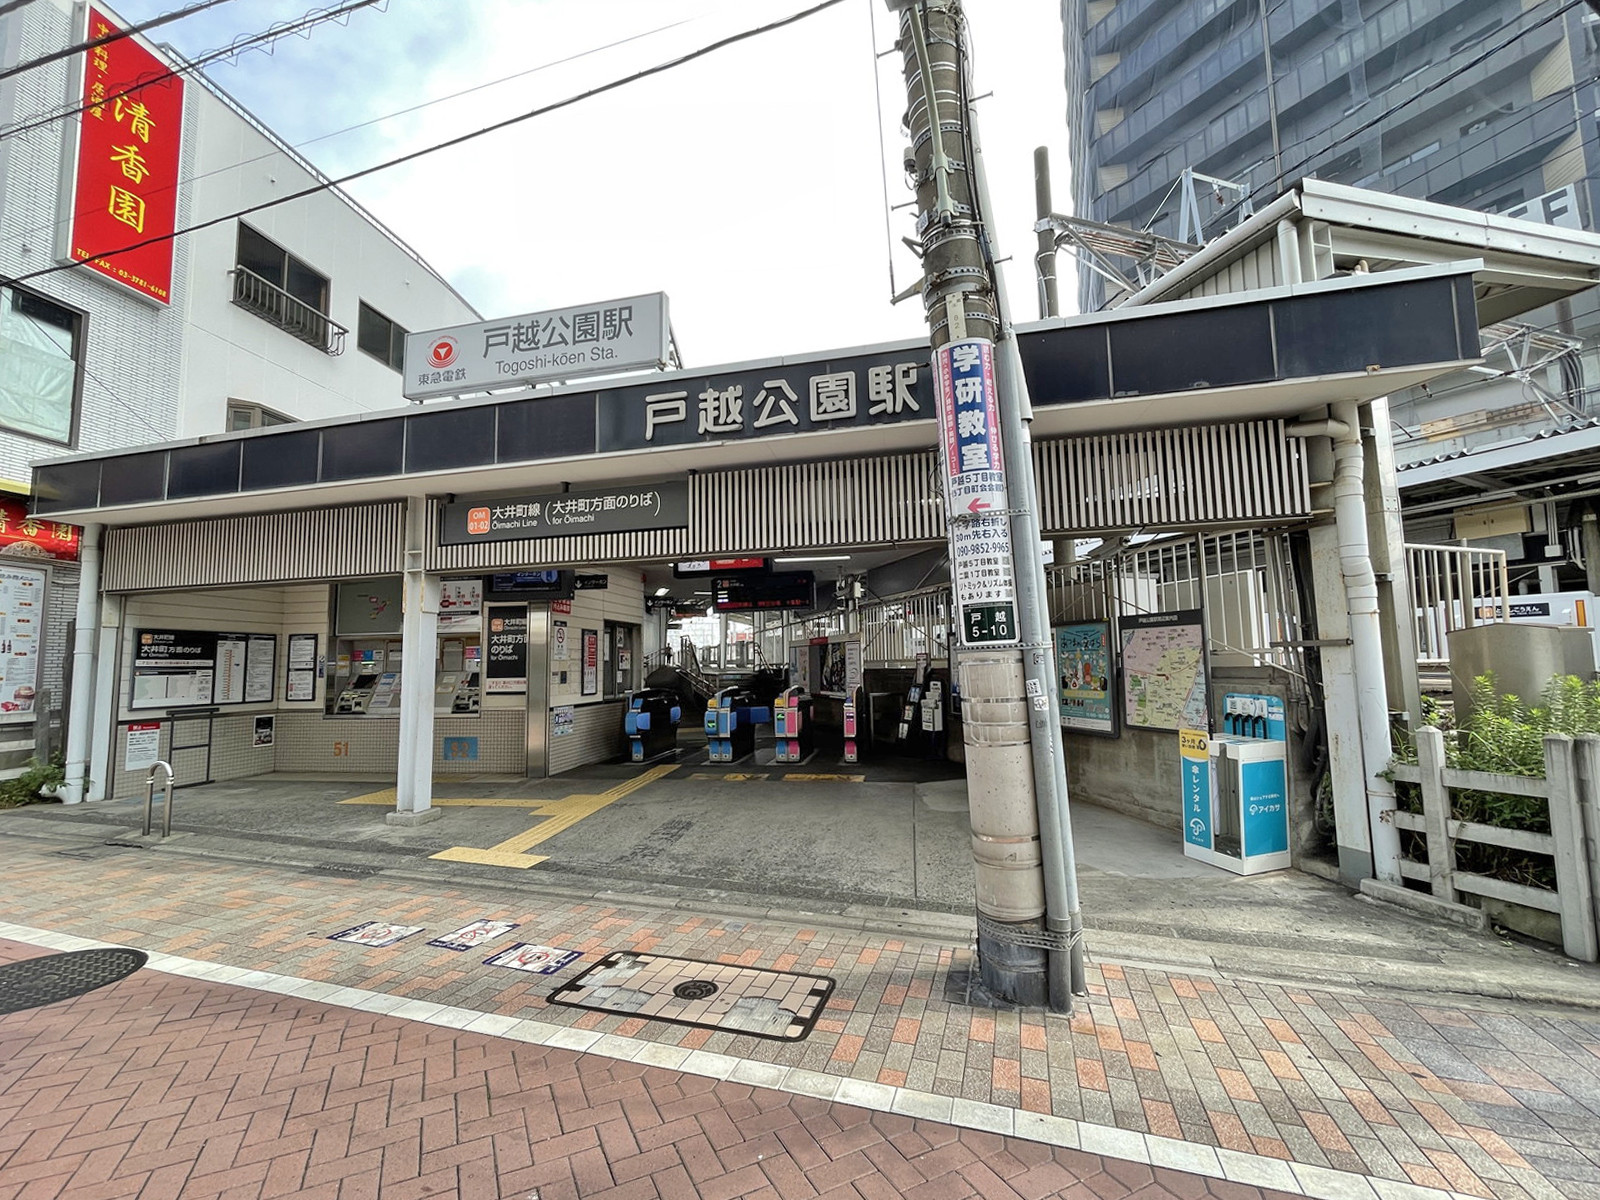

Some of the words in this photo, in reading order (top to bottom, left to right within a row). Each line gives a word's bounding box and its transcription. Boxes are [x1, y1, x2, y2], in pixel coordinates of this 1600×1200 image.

[109, 90, 156, 234] 清香園
[482, 305, 633, 359] 戸越公園駅
[495, 352, 586, 376] Togoshi-kōen
[591, 347, 618, 361] Sta.
[418, 367, 467, 386] 東急電鉄
[645, 362, 920, 441] 戸越公園駅
[953, 345, 990, 471] 学研教室
[472, 511, 486, 520] OM
[492, 504, 541, 520] 大井町線
[522, 519, 538, 528] Line
[552, 517, 562, 525] for
[972, 624, 1008, 638] 5-10
[333, 741, 349, 757] 51
